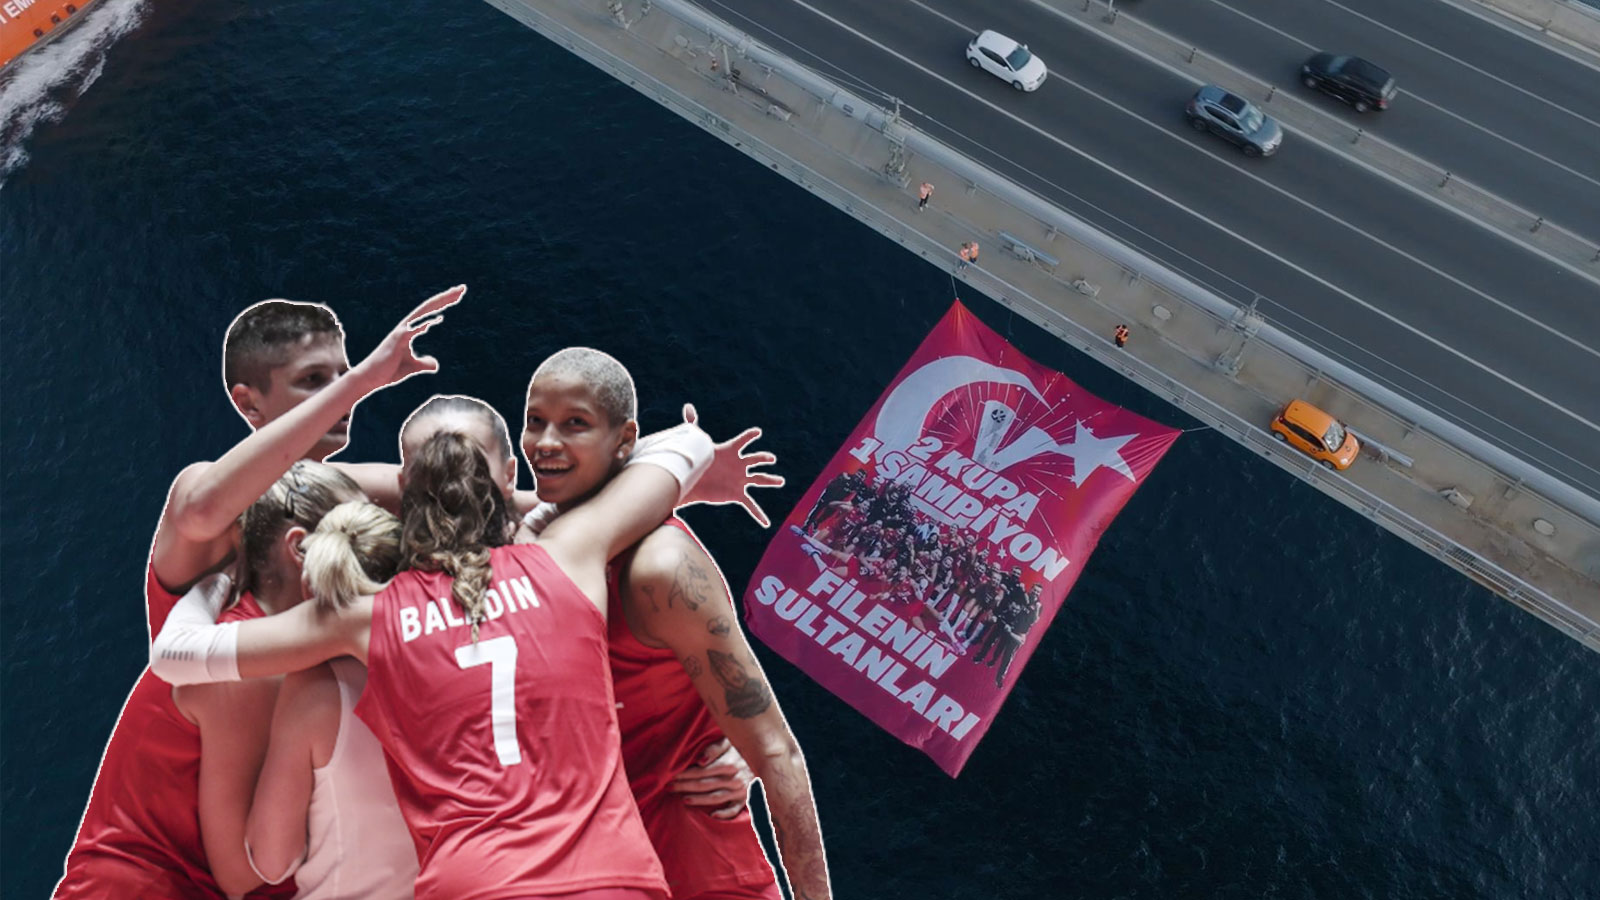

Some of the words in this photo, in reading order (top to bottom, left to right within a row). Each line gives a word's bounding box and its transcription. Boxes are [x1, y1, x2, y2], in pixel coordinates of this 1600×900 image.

[848, 437, 881, 464] 1
[873, 451, 1071, 582] ŞAMPİYON
[908, 436, 943, 461] 2
[934, 450, 1040, 523] KUPA
[754, 575, 981, 742] SULTANLARI
[806, 570, 959, 680] FİLENİN
[454, 635, 522, 766] 7
